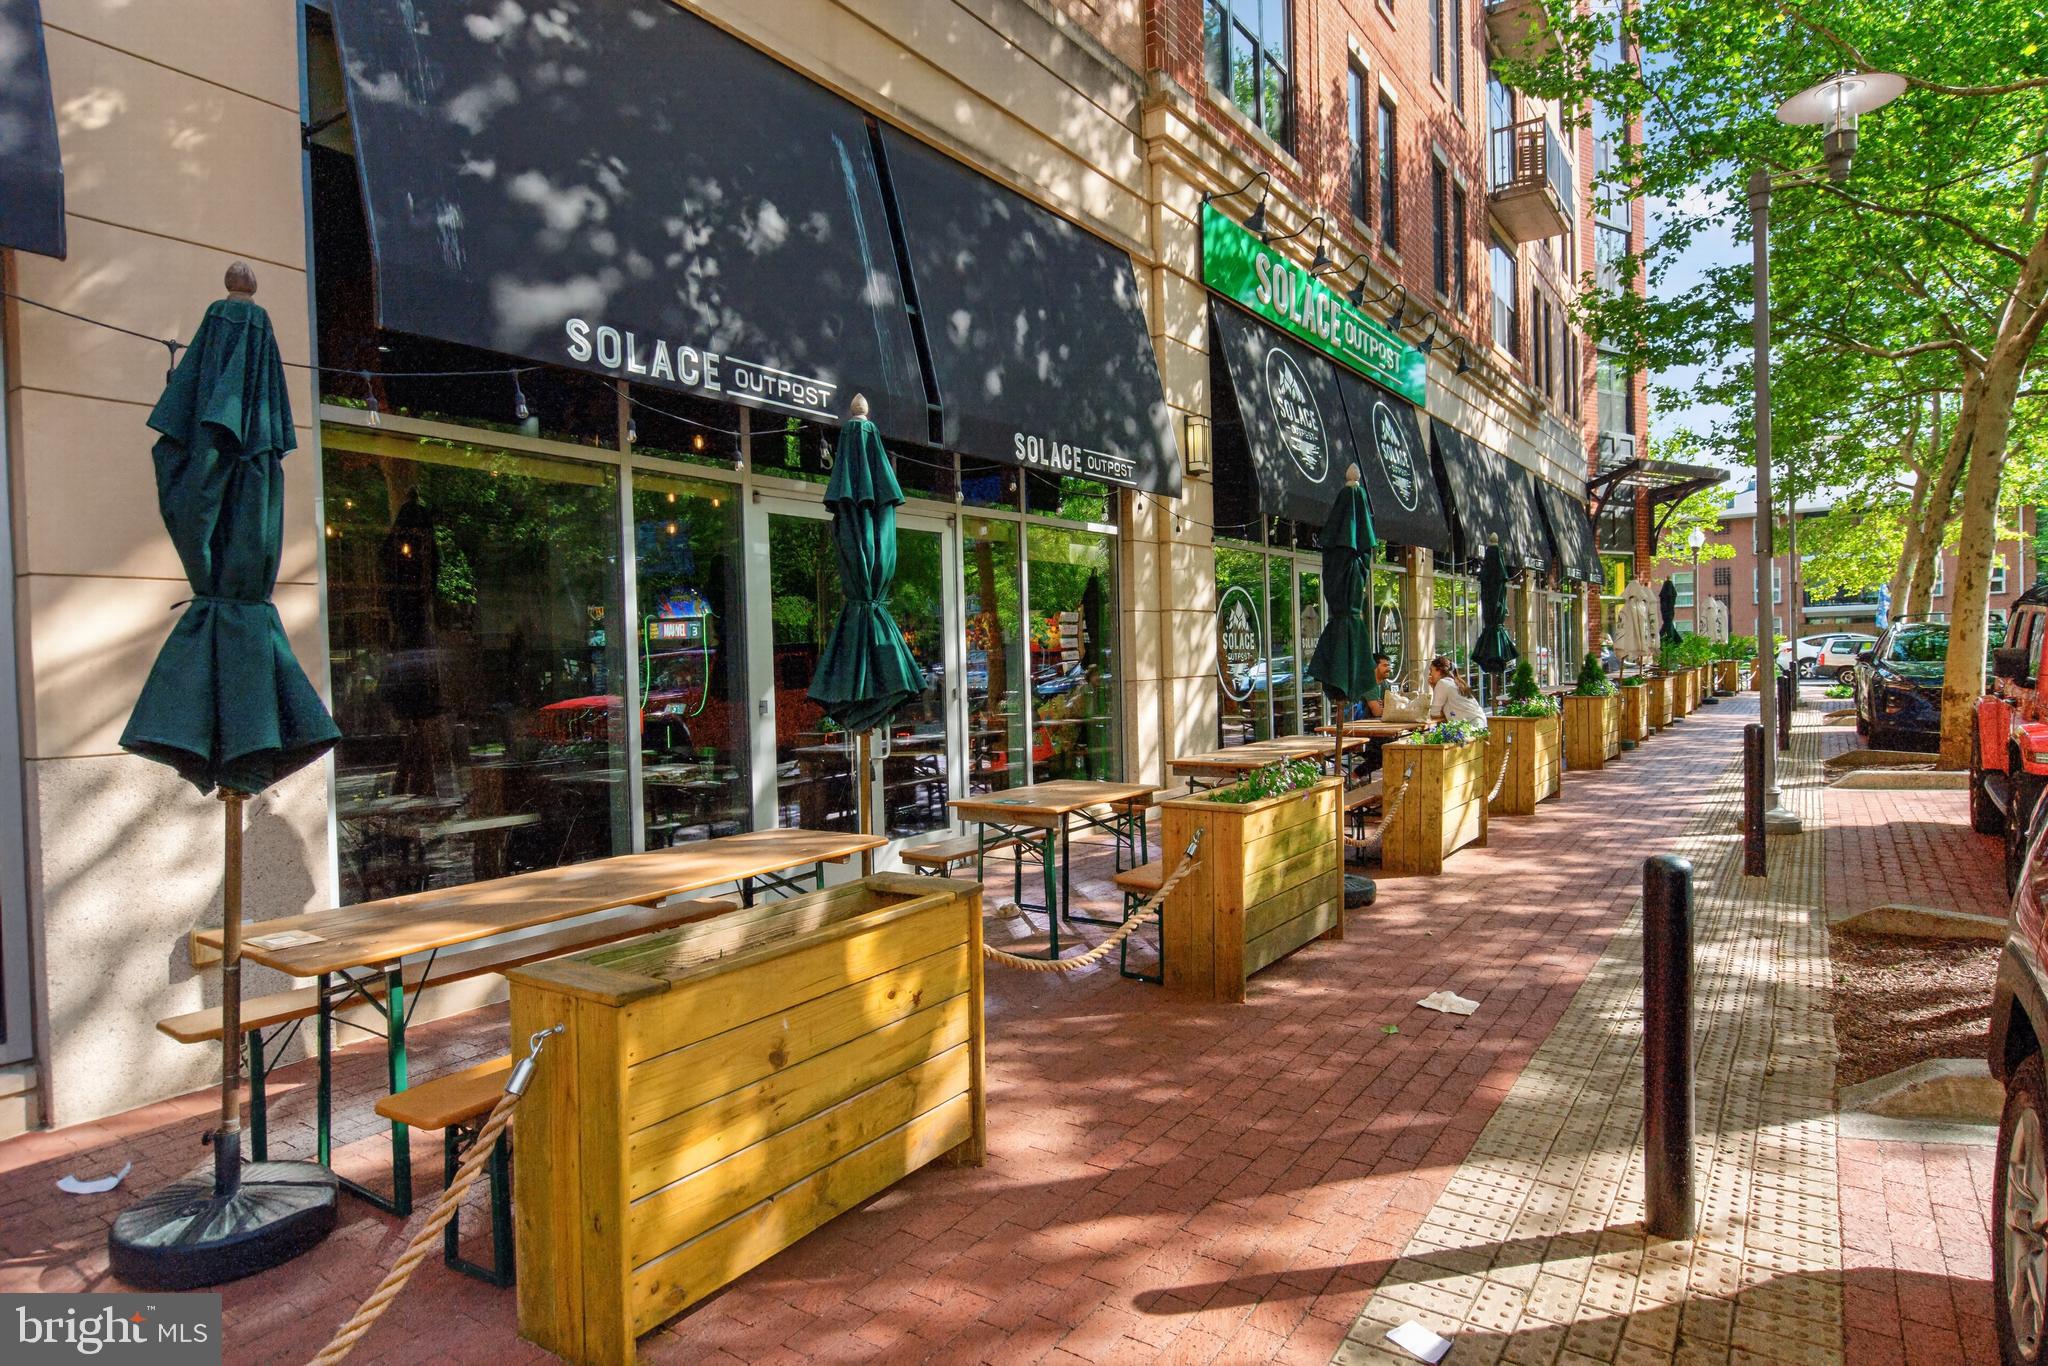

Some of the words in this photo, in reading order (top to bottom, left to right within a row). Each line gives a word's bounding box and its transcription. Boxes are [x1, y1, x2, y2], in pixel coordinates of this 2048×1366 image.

[1255, 252, 1342, 348] SOLACE
[1344, 320, 1401, 374] OUTPOST
[566, 318, 721, 391] SOLACE
[734, 368, 831, 408] OUTPOST
[1276, 396, 1319, 431] SOLACE
[1014, 432, 1083, 473] SOLACE
[1087, 456, 1134, 479] OUTPOST
[1222, 632, 1255, 649] SOLACE
